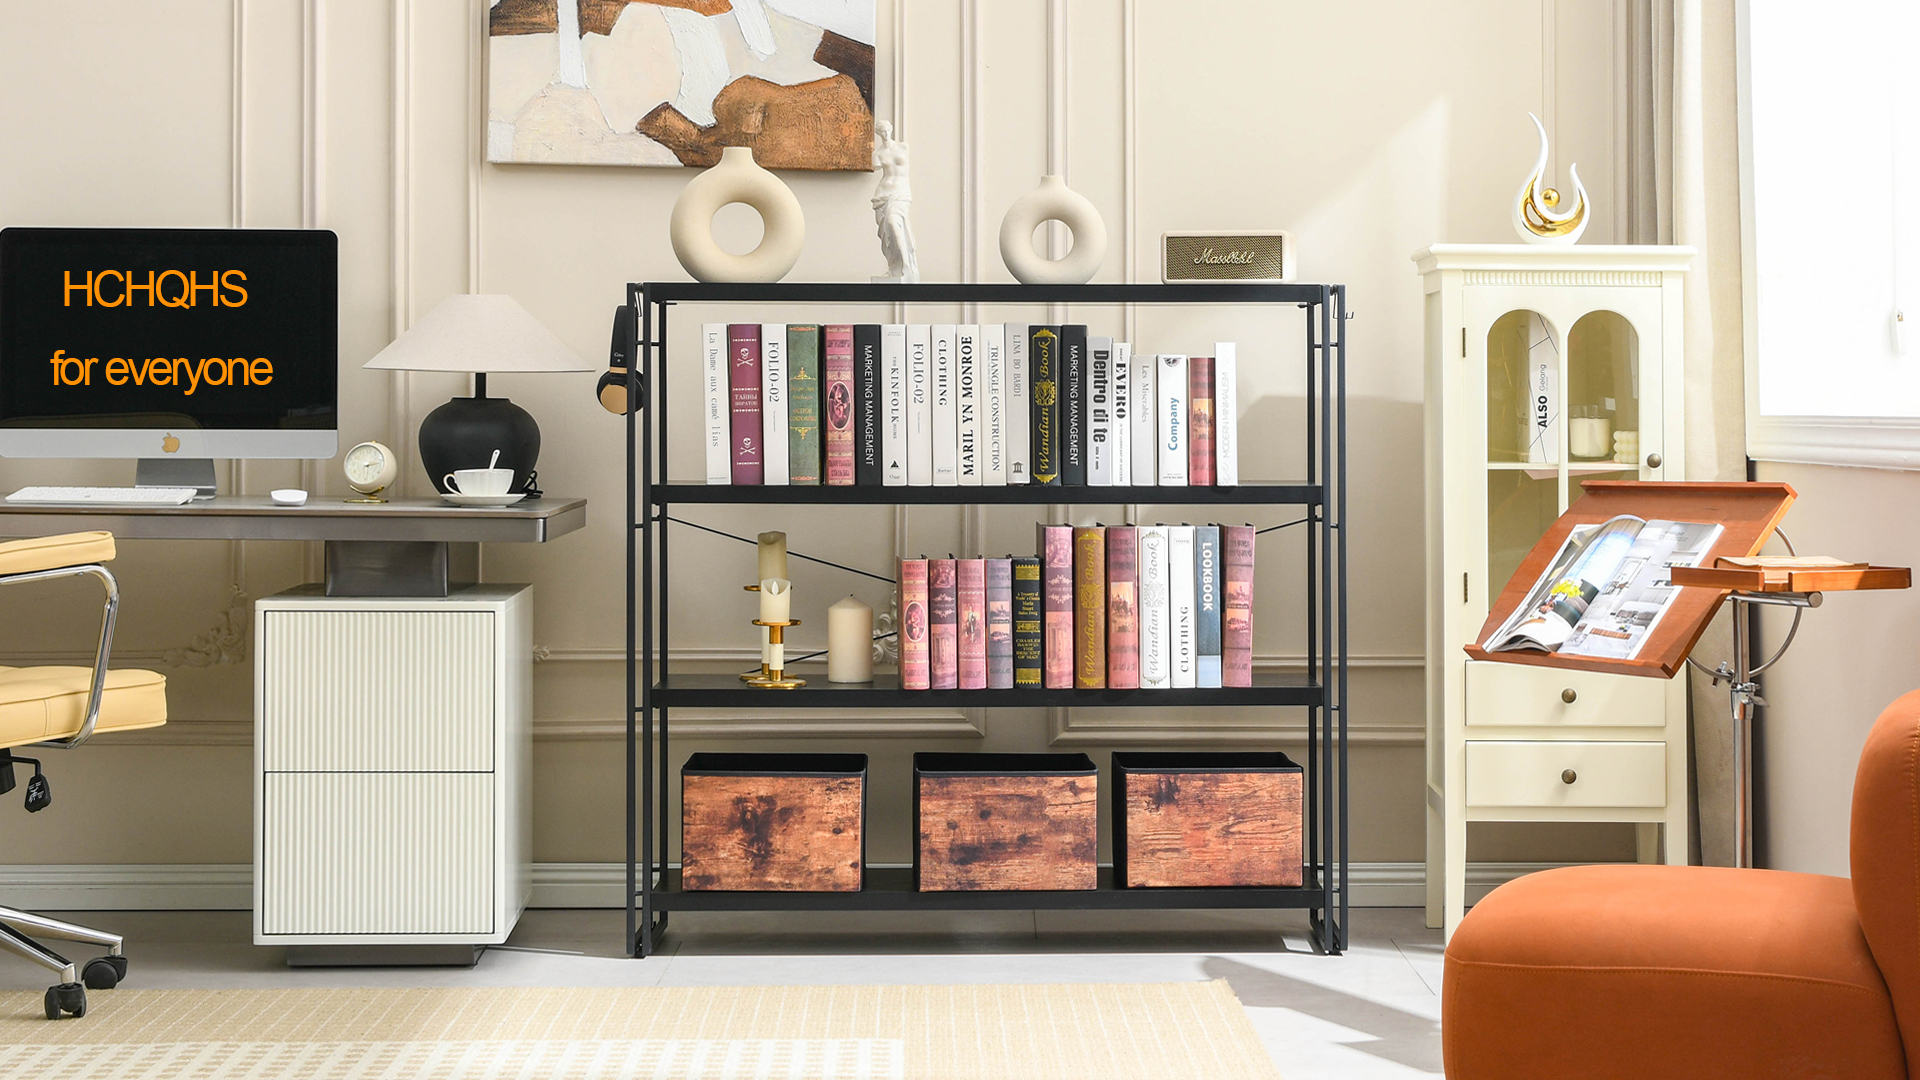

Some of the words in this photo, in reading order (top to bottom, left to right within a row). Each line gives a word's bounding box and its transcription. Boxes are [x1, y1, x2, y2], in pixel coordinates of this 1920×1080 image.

[63, 269, 249, 310] HCHQHS
[709, 332, 718, 344] La
[709, 348, 719, 371] Dame
[1013, 335, 1021, 354] LINA
[1038, 337, 1051, 378] Book
[50, 349, 99, 386] for
[105, 357, 274, 396] everyone
[710, 376, 718, 392] aux
[768, 342, 780, 403] FOLIO-02
[864, 344, 874, 398] MARKETING
[912, 343, 925, 404] FOLIO-02
[937, 339, 948, 406] CLOTHING
[961, 335, 973, 398] MONROE
[991, 345, 999, 394] TRIANGLE
[1013, 373, 1021, 397] BARDI
[1069, 345, 1079, 398] MARKETING
[1093, 350, 1109, 403] Dentro
[1115, 362, 1126, 419] EVERO
[1141, 365, 1149, 379] Les
[890, 367, 899, 423] KINFOLK
[962, 404, 974, 424] YN
[1093, 408, 1109, 423] di
[1221, 372, 1230, 420] MINIMALISM
[1537, 395, 1548, 428] ALSO
[865, 400, 875, 466] MANAGEMENT
[991, 396, 1000, 472] CONSTRUCTION
[1037, 407, 1050, 472] Wandian
[1069, 400, 1079, 466] MANAGEMENT
[1093, 427, 1108, 443] te
[1167, 397, 1180, 451] Company
[1222, 422, 1230, 458] MODERN
[963, 429, 974, 476] MARIL
[1083, 540, 1096, 580] Book
[1147, 539, 1160, 580] Book
[1202, 542, 1214, 611] LOOKBOOK
[1083, 609, 1096, 675] Wandian
[1148, 609, 1159, 675] Wandian
[1180, 606, 1189, 673] CLOTHING
